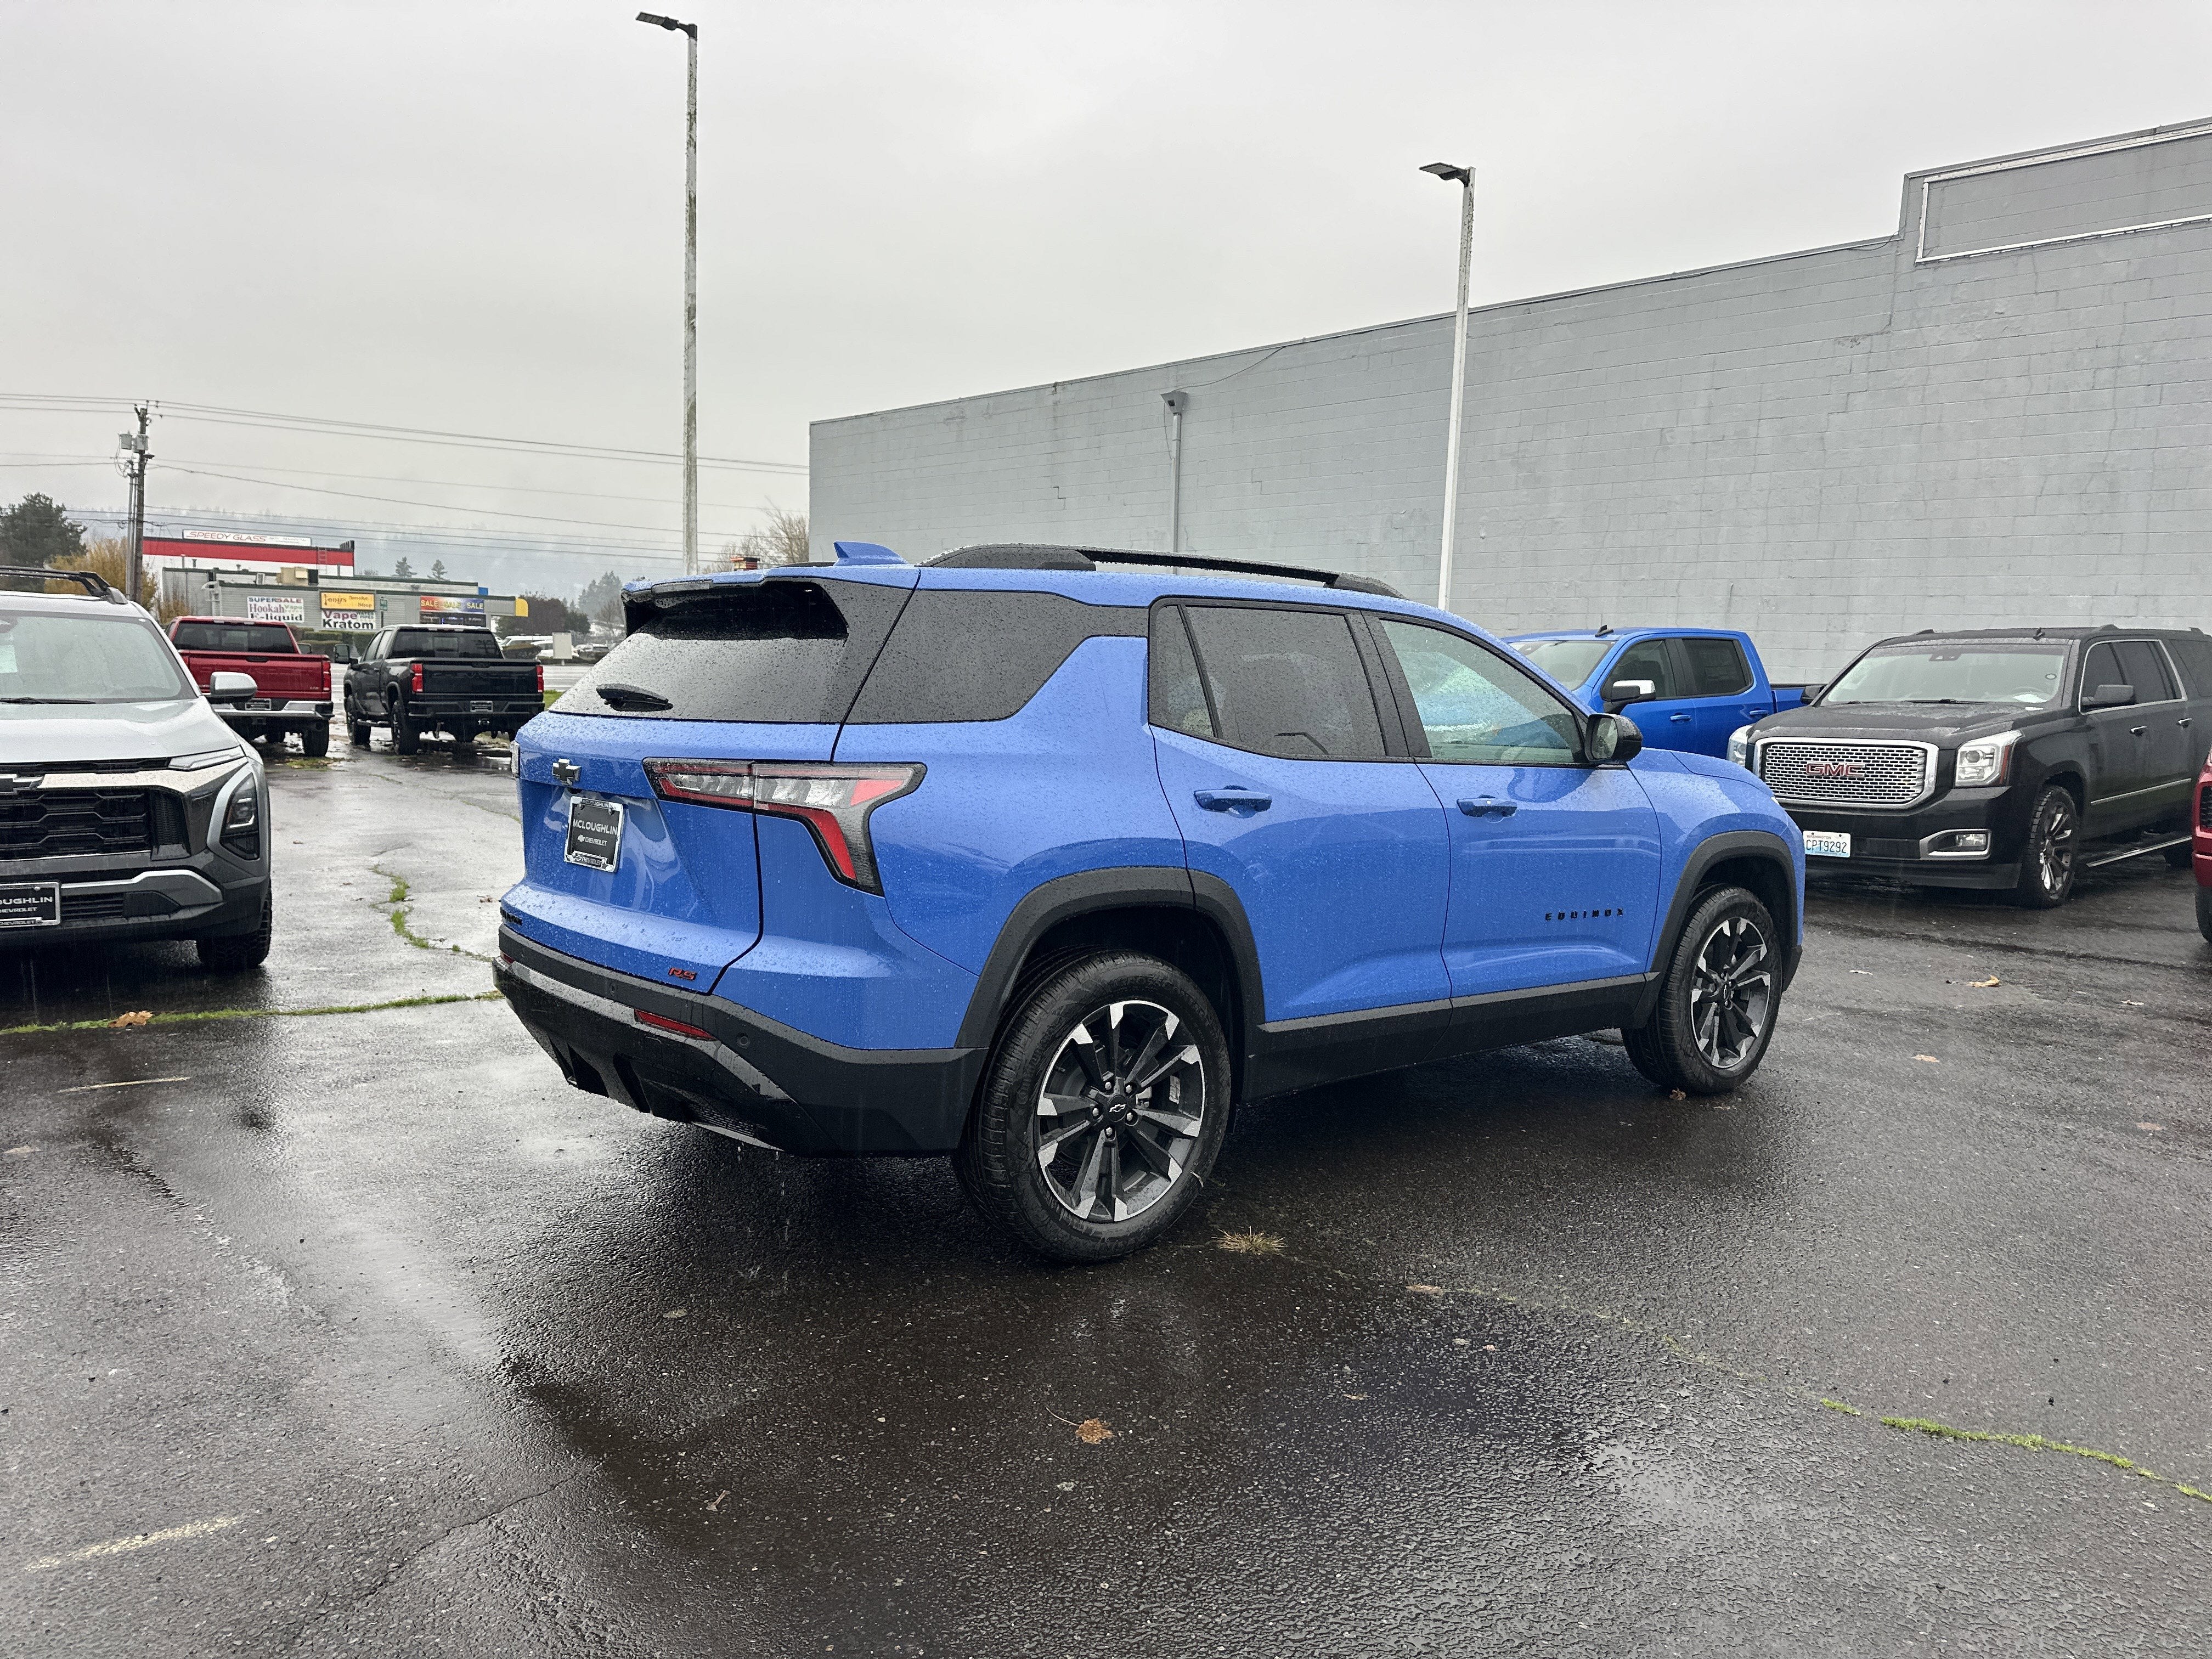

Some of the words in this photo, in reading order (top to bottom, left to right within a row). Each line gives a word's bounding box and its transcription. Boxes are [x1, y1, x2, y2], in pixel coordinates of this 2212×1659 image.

[187, 532, 231, 540] SPEEDY
[233, 534, 267, 542] GLASS
[250, 603, 284, 613] Hookah
[443, 600, 460, 608] SALE
[323, 610, 358, 620] Vape
[323, 619, 374, 629] Kratom
[1806, 763, 1865, 777] GMC
[573, 819, 618, 835] MCLOUGHLIN
[585, 837, 607, 846] CHEVROLET
[1806, 839, 1847, 853] CPT9292
[1545, 908, 1624, 921] EQUINOX
[668, 967, 698, 981] RS
